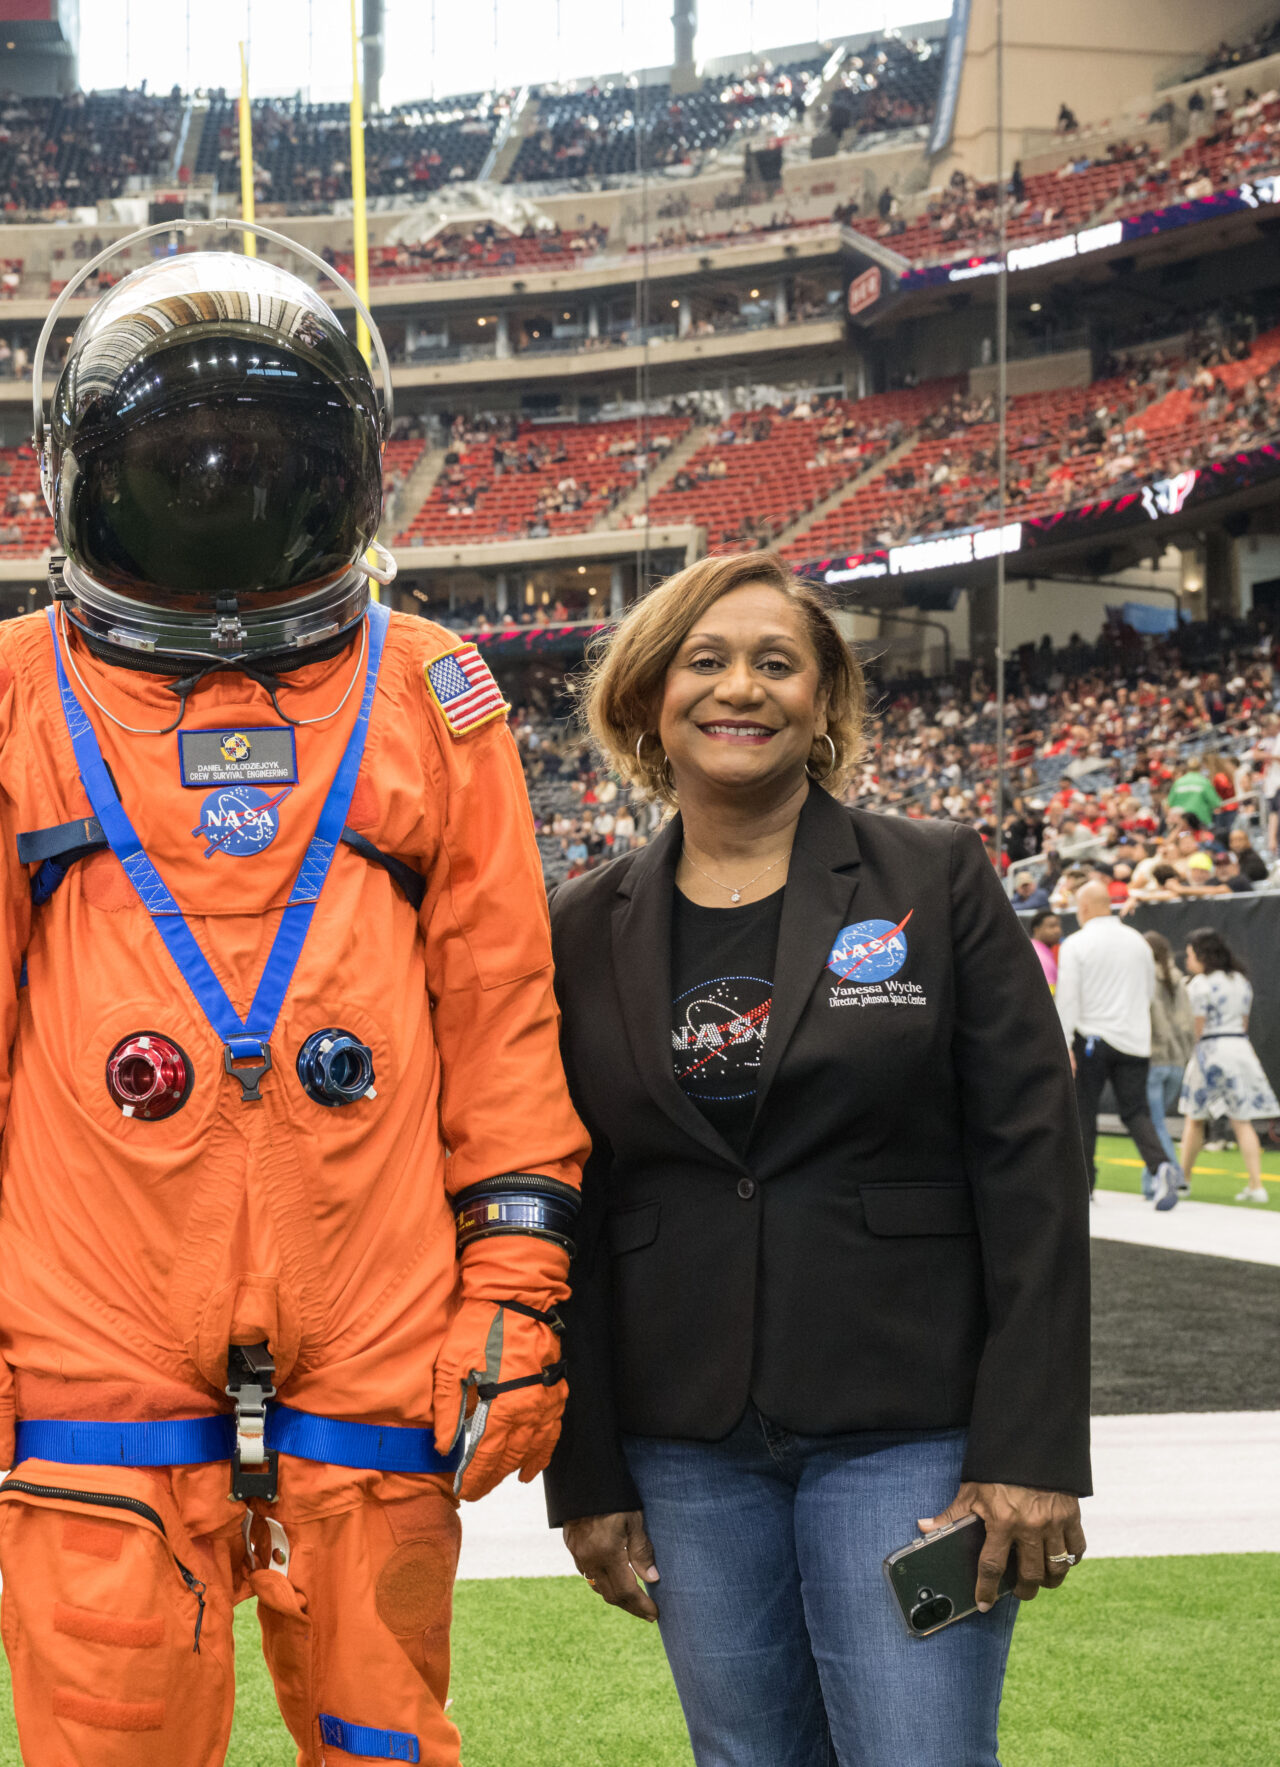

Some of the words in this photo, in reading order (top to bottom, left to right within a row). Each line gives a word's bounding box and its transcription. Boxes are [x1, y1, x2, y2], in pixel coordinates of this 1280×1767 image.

[189, 772, 209, 781] CREW
[213, 770, 245, 780] SURVIVAL
[247, 768, 289, 779] ENGINEERING
[197, 764, 223, 772] DANIEL
[206, 809, 275, 827] NASA
[831, 936, 905, 963] NASA
[830, 985, 883, 997] Vanessa
[884, 980, 923, 994] Wyche
[829, 996, 861, 1008] Director,
[860, 994, 890, 1007] Johnson
[889, 992, 908, 1006] Space
[907, 993, 927, 1005] Center
